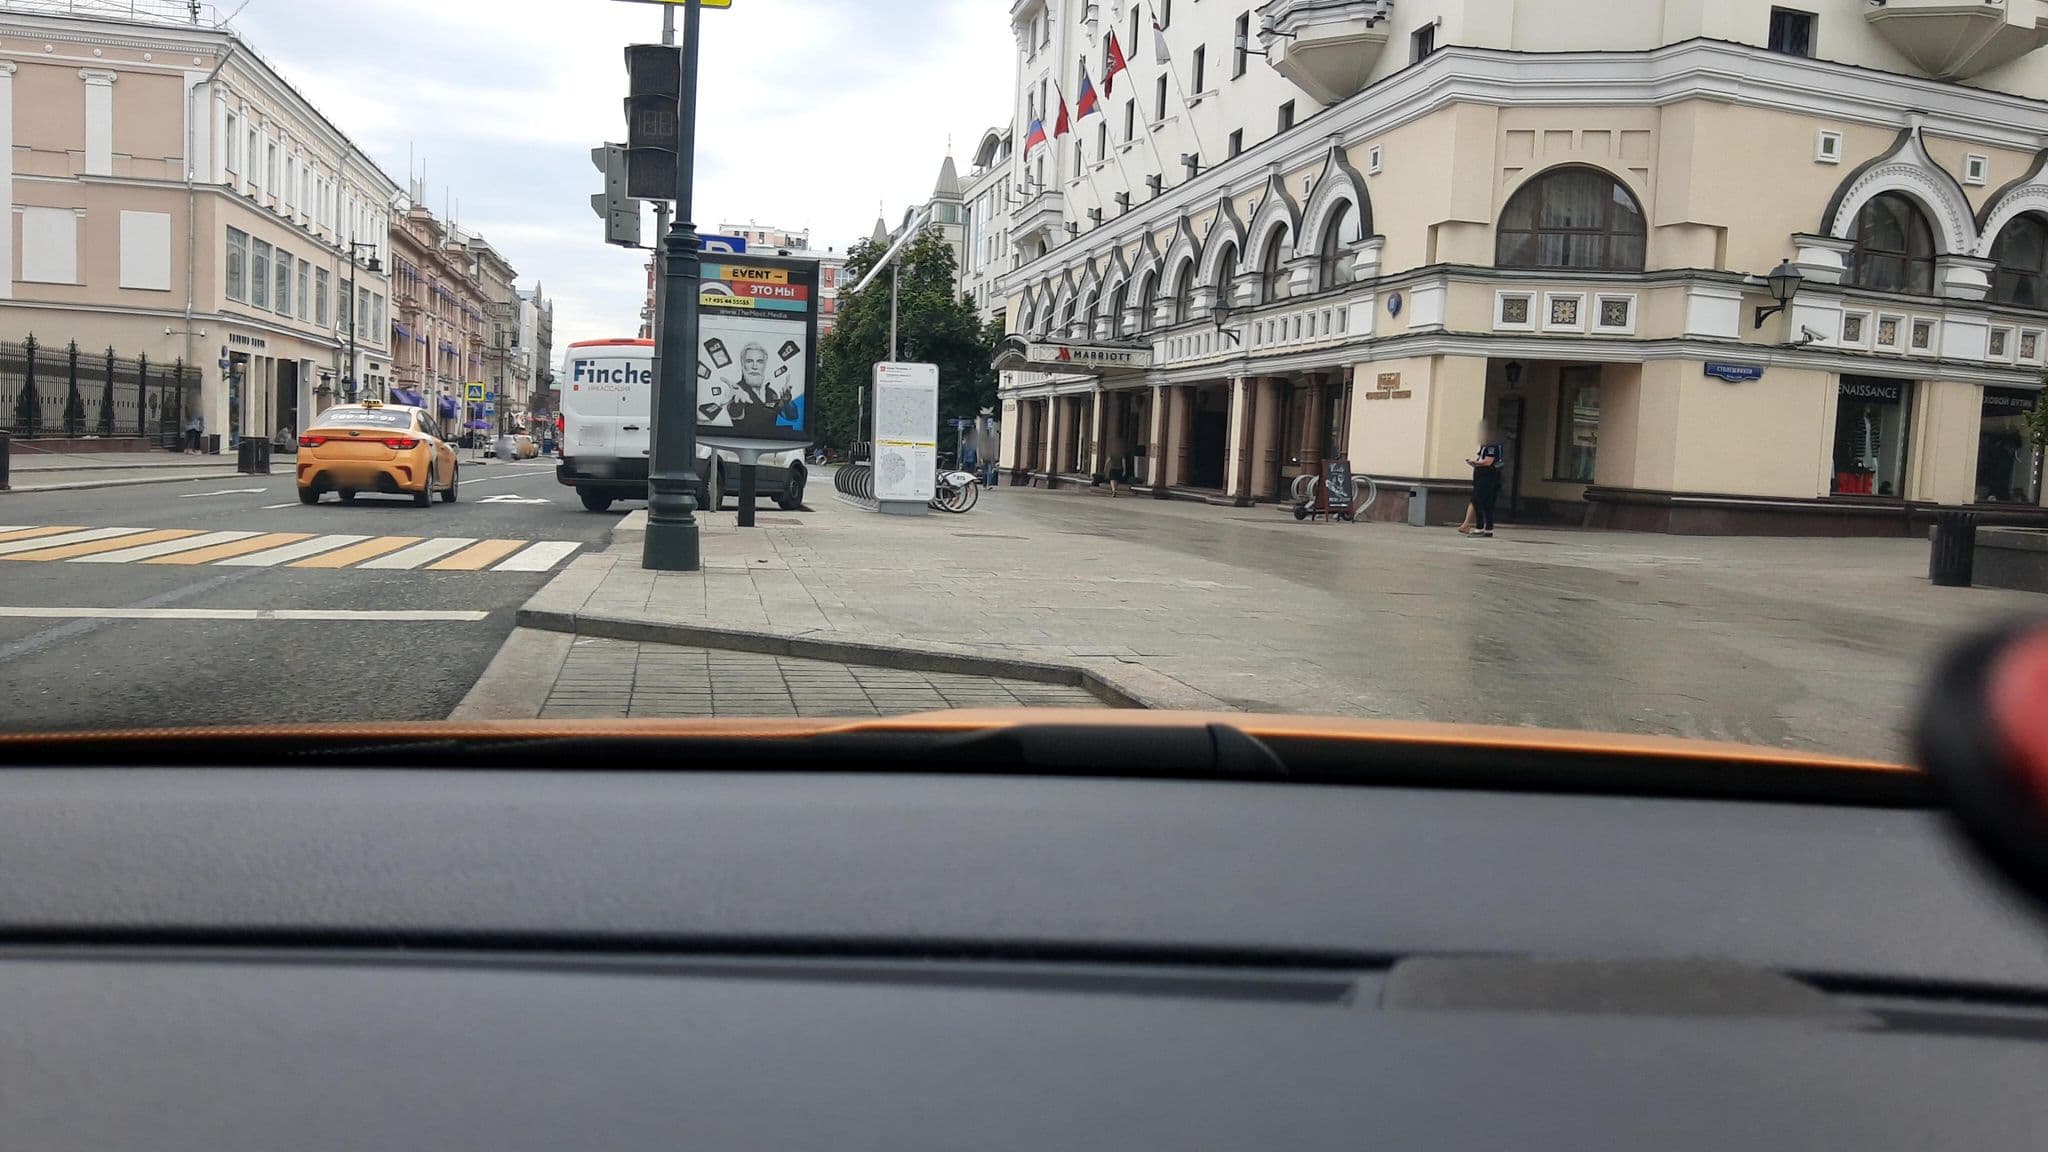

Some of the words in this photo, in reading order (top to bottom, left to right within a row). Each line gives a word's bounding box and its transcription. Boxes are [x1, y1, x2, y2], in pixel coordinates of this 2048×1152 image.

[732, 268, 771, 280] EVENT
[750, 285, 773, 295] ЭТО
[775, 286, 794, 297] МЫ
[1073, 350, 1132, 362] MARRIOTT
